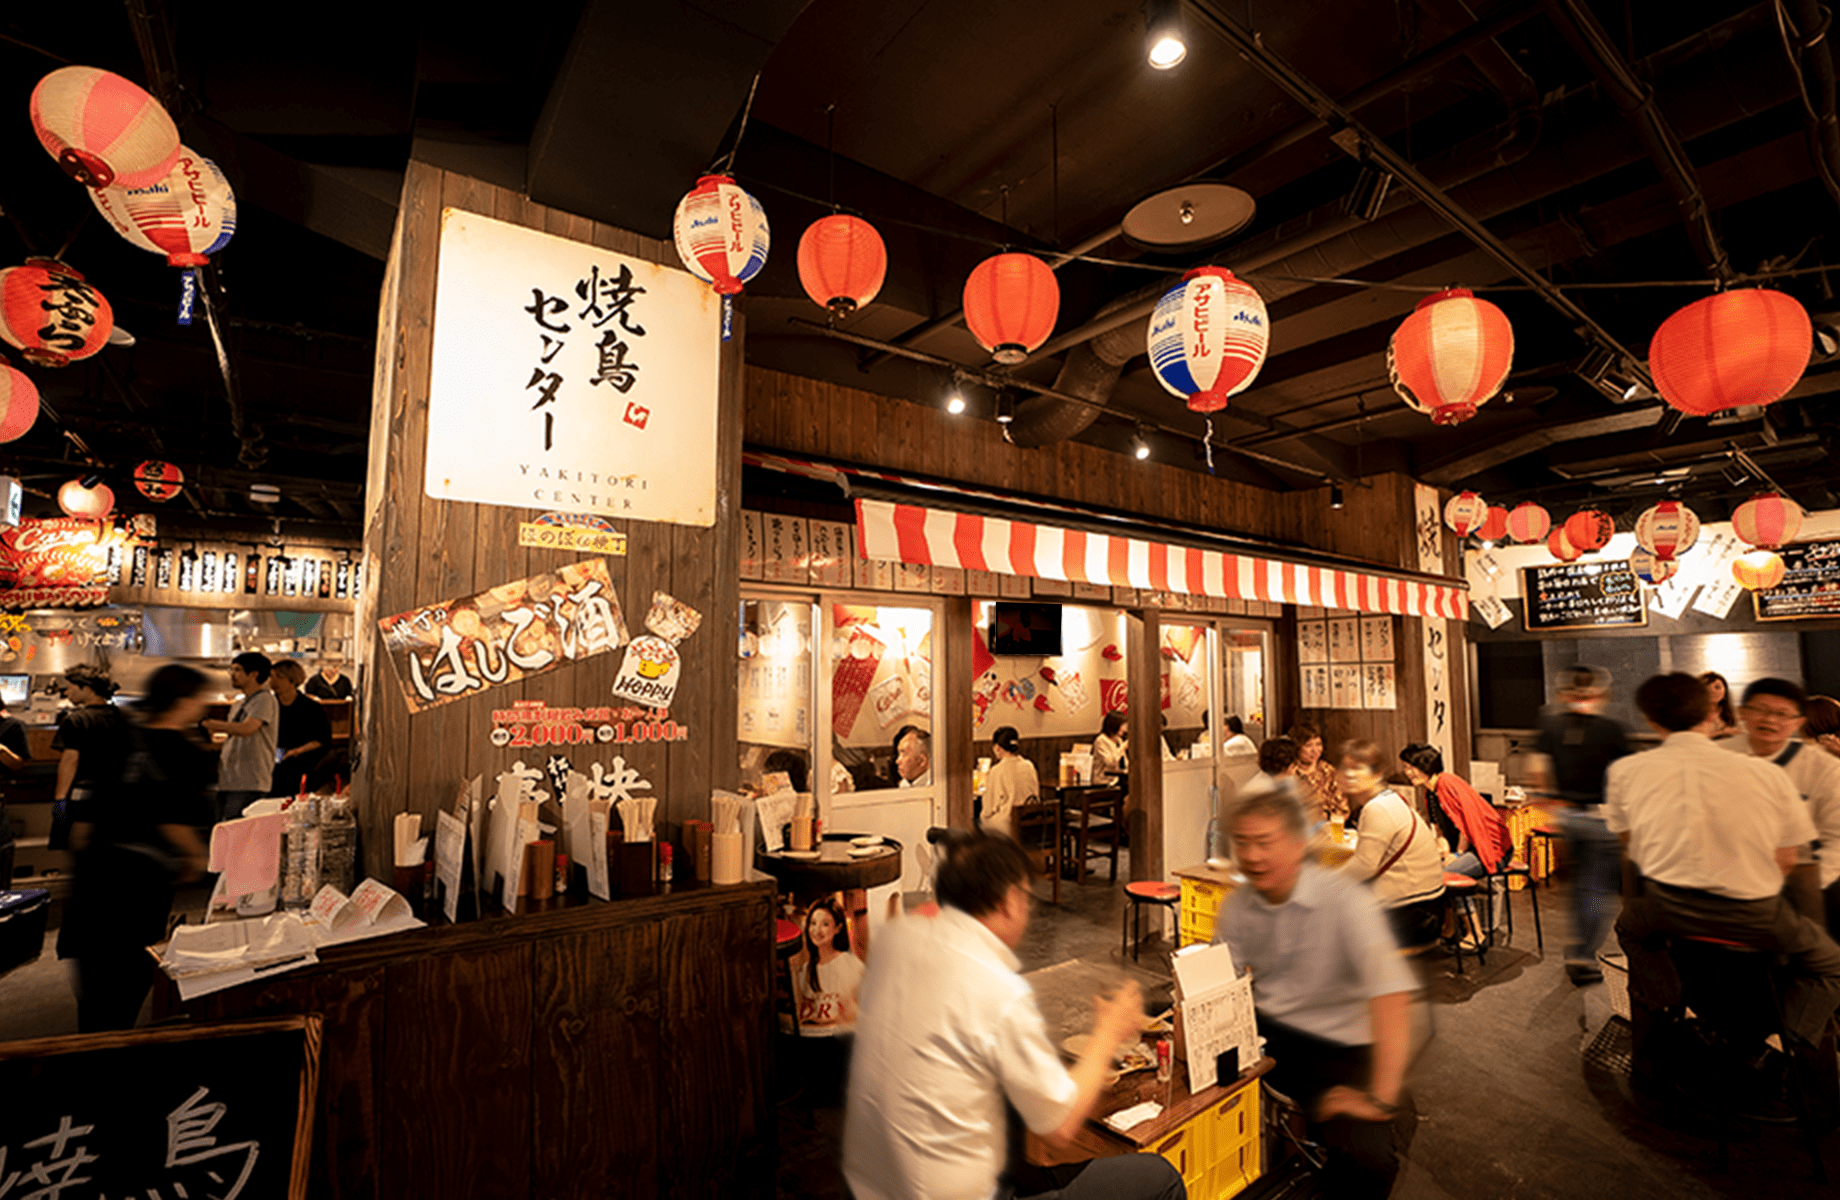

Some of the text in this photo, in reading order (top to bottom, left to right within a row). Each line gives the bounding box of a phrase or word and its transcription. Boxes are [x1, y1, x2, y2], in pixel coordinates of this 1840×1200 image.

[127, 184, 169, 196] sahi
[179, 157, 211, 228] アサヒビール
[726, 192, 744, 253] アサヒビール
[575, 264, 647, 395] 焼鳥
[1192, 283, 1212, 358] アサヒビール
[524, 288, 572, 452] センター
[519, 463, 649, 491] YAKITORI
[533, 487, 633, 511] CENTER
[409, 580, 620, 700] はしご酒
